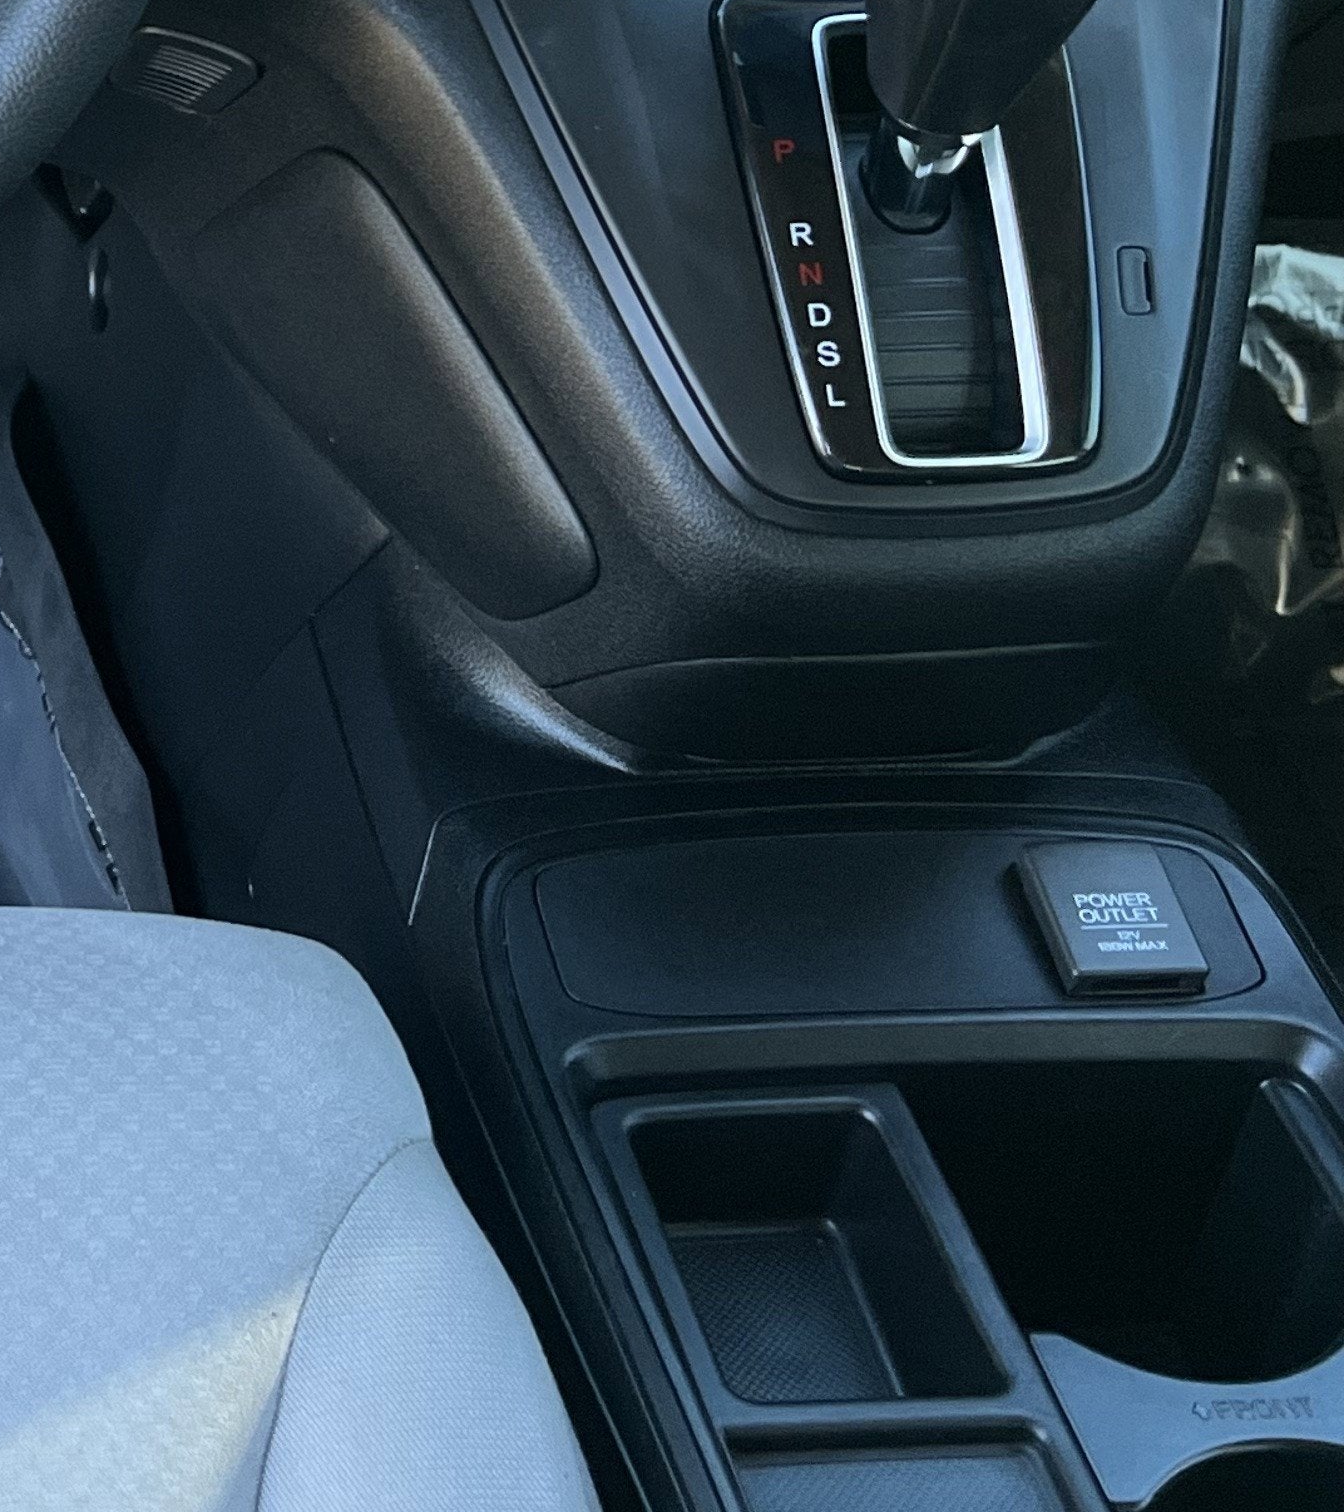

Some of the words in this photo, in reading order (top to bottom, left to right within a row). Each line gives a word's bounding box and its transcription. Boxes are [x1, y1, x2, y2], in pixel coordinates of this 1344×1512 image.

[772, 138, 795, 164] P
[789, 222, 814, 246] R
[799, 261, 823, 287] N
[807, 303, 832, 327] D
[817, 340, 841, 367] S
[826, 384, 846, 408] L
[1072, 892, 1151, 909] POWER
[1079, 907, 1159, 924] OUTLET
[1136, 940, 1169, 952] MAX
